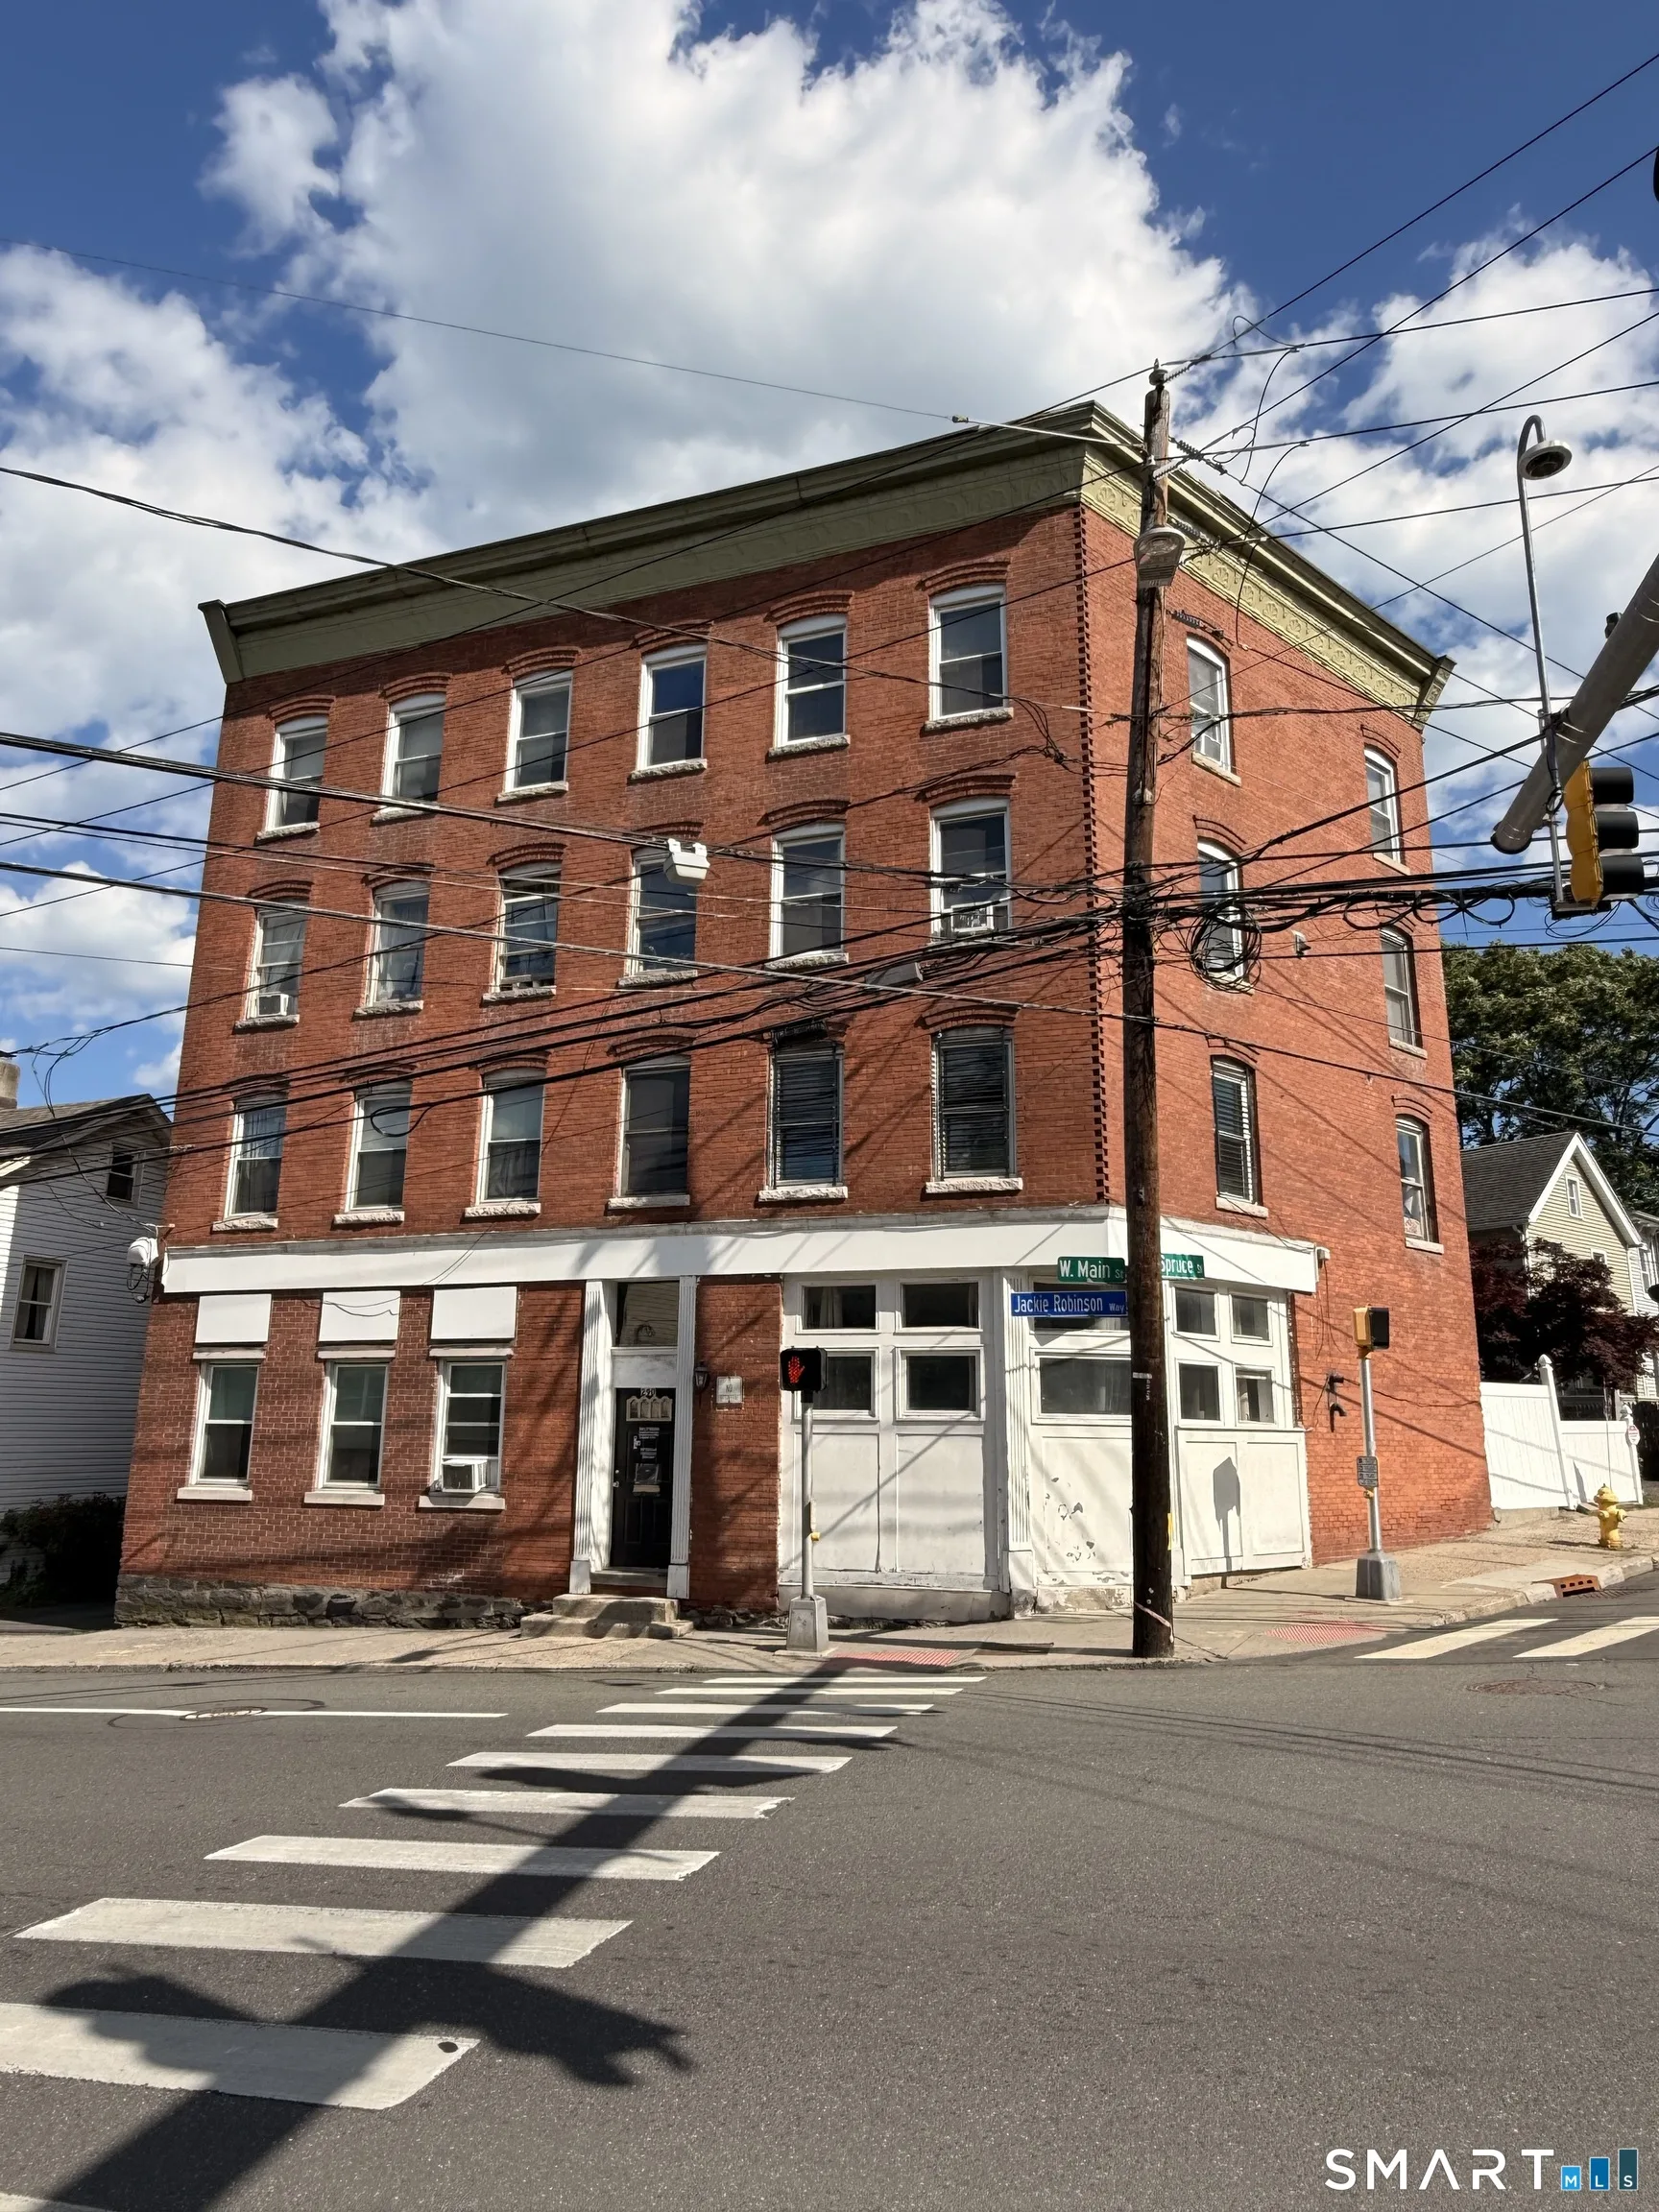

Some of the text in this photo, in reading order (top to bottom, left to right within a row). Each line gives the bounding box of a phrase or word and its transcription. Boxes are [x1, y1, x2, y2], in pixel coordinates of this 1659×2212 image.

[1059, 1260, 1124, 1279] W. Main St
[1161, 1254, 1193, 1276] Spruce
[1014, 1294, 1125, 1313] Jackie Robinson Way
